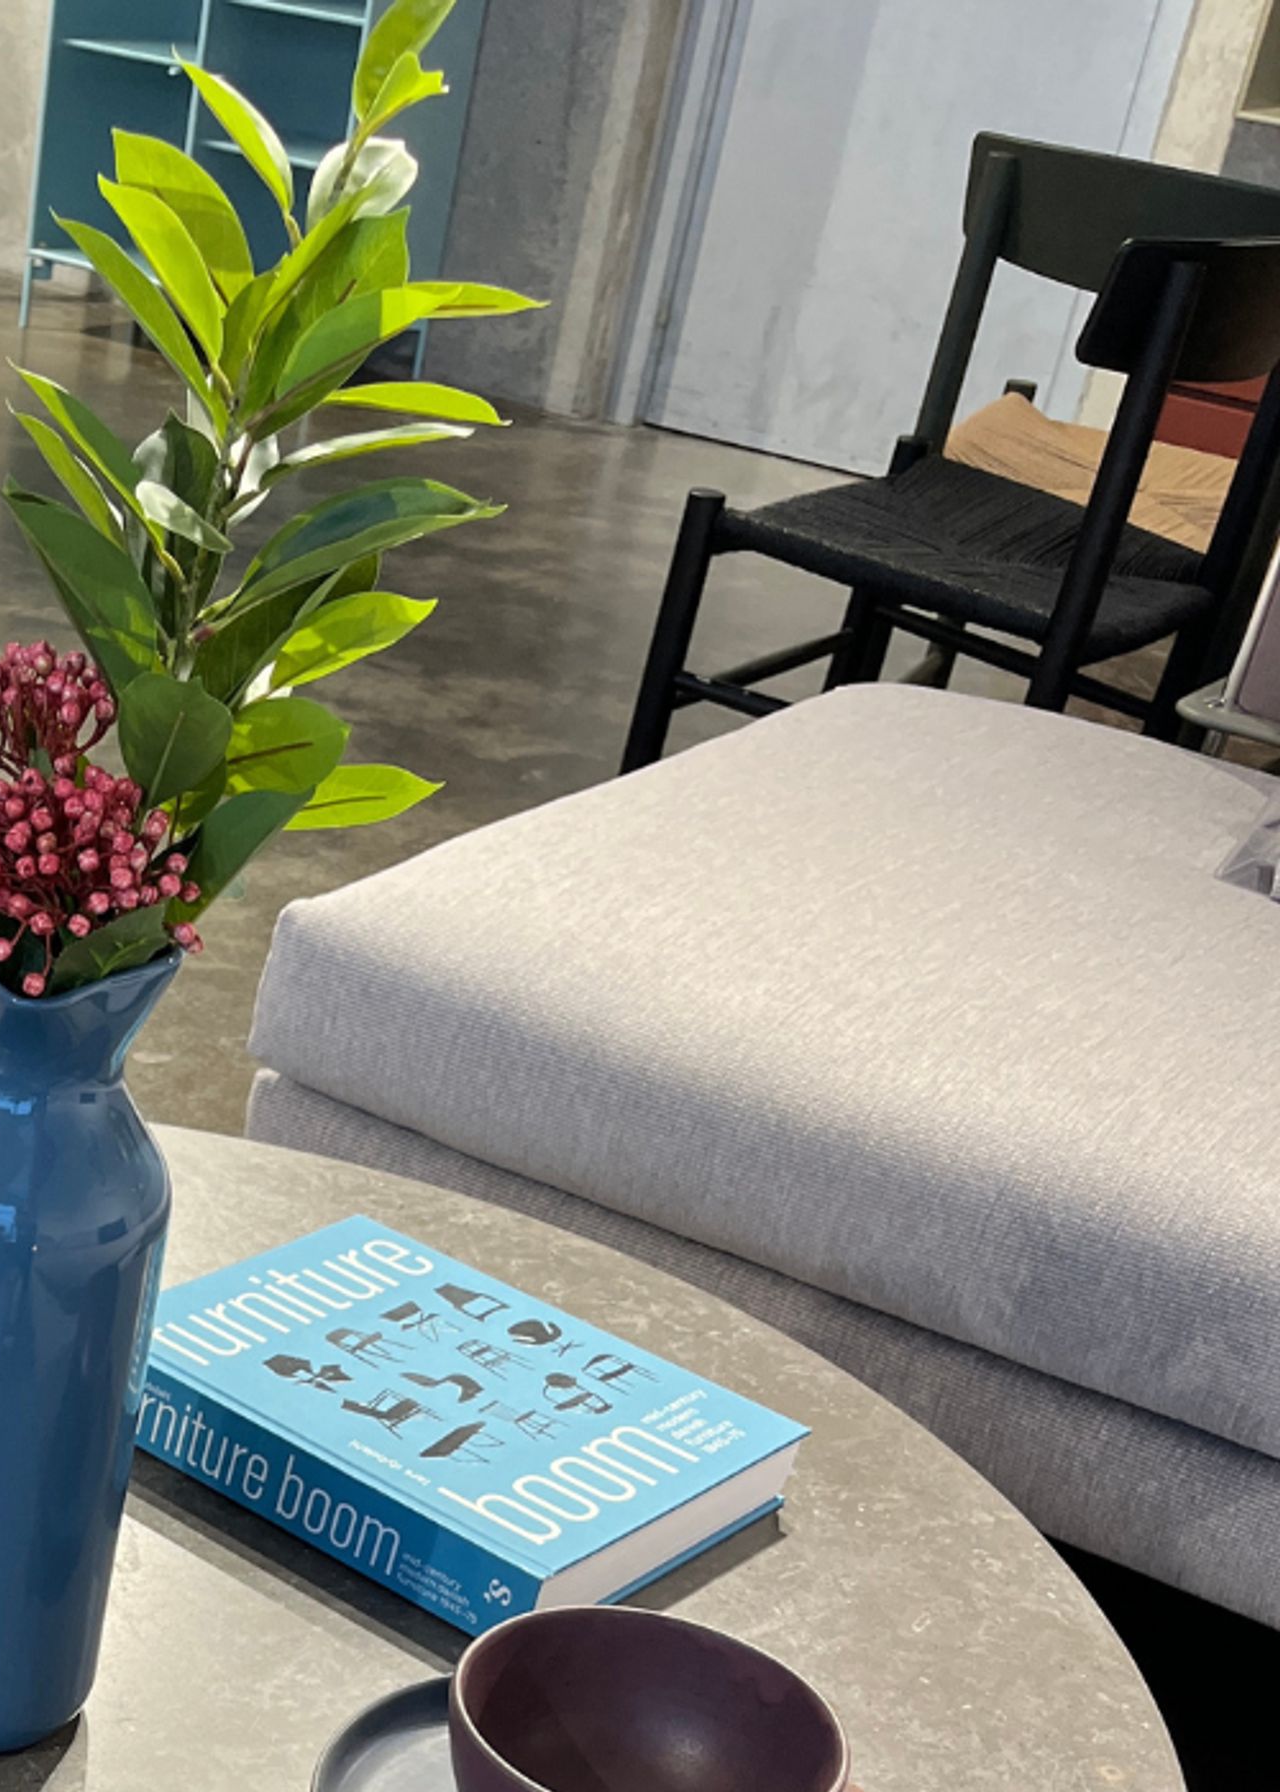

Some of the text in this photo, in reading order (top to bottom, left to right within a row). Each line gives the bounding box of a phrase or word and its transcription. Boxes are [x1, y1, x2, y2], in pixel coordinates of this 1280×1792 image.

[134, 1392, 402, 1576] rniture boom
[437, 1425, 700, 1545] boom
